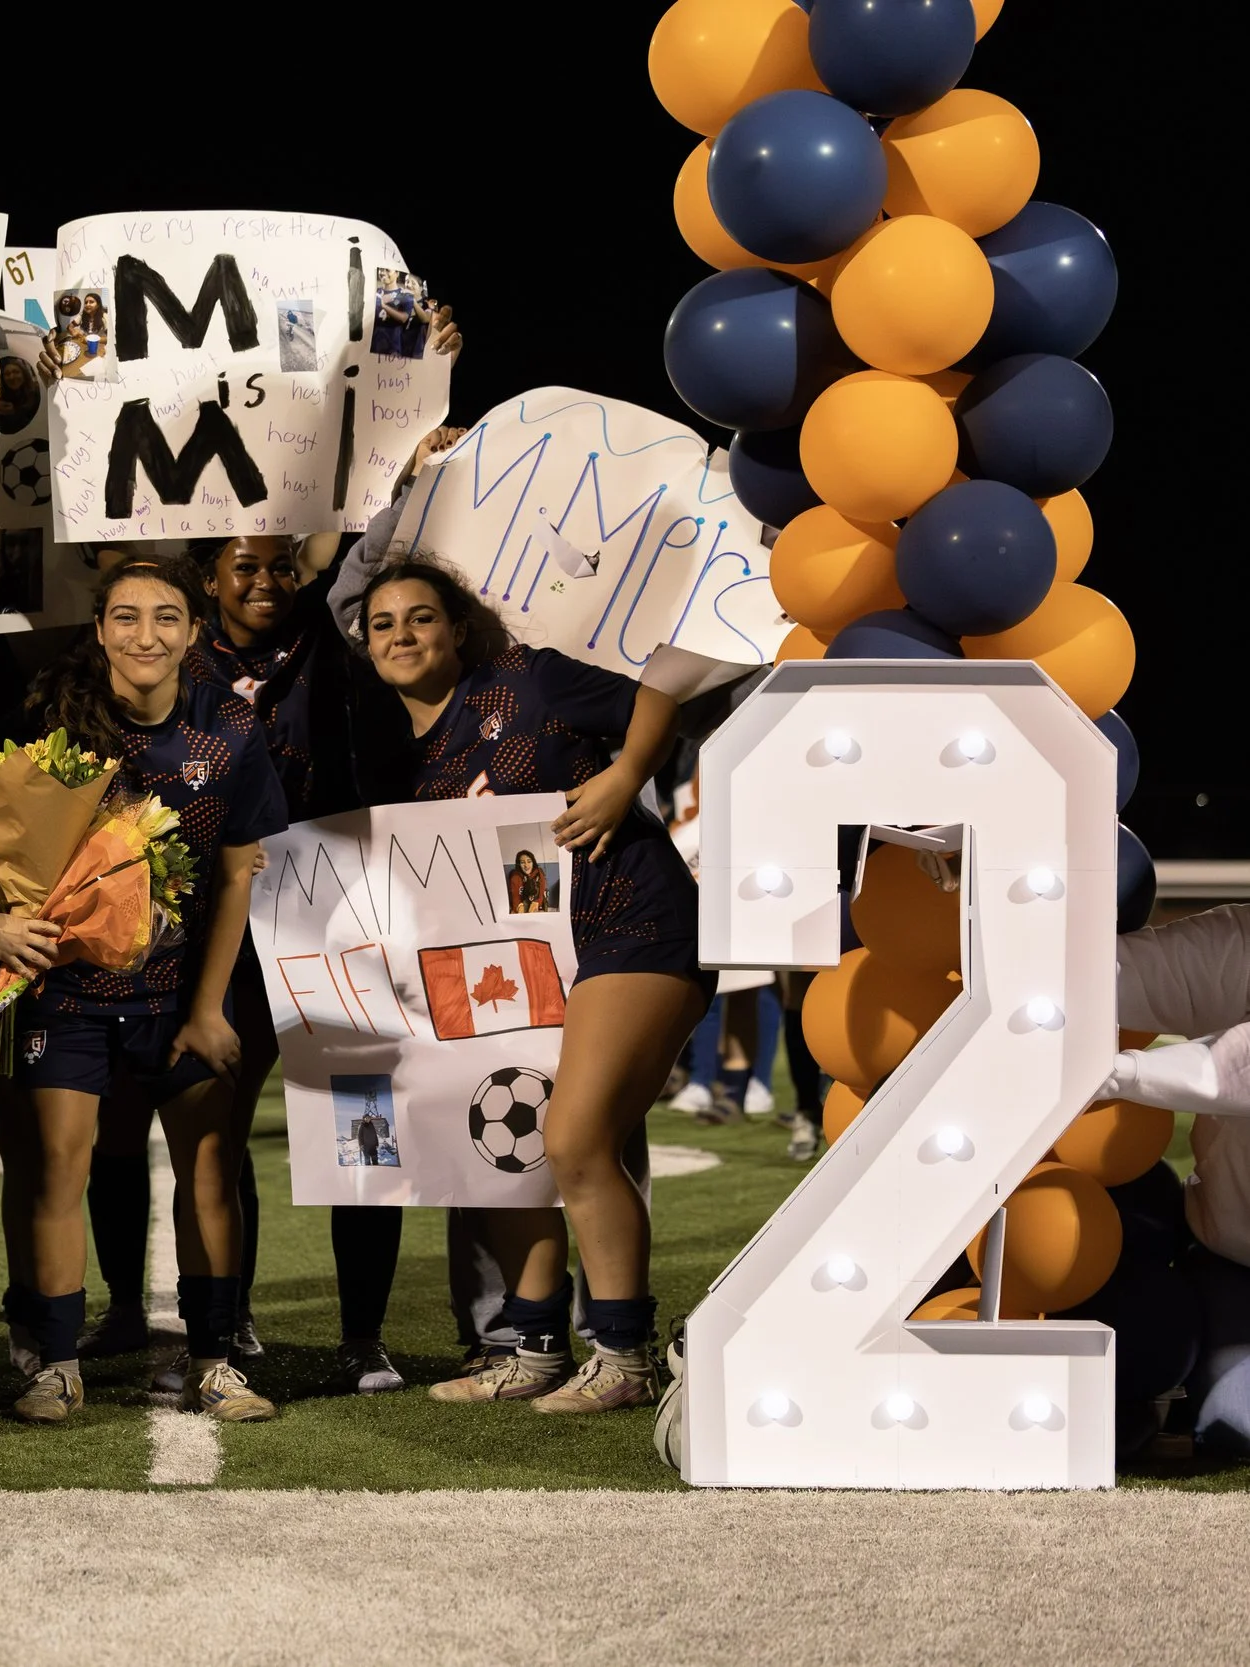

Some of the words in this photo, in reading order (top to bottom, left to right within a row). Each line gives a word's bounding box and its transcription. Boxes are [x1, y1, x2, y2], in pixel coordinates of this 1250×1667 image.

[123, 217, 194, 246] very
[5, 251, 34, 285] 67
[217, 371, 266, 410] is
[267, 421, 318, 455] hoyt
[197, 767, 205, 781] G
[273, 829, 497, 946] MIMI
[276, 942, 416, 1036] FIFI
[682, 659, 1118, 1490] 2
